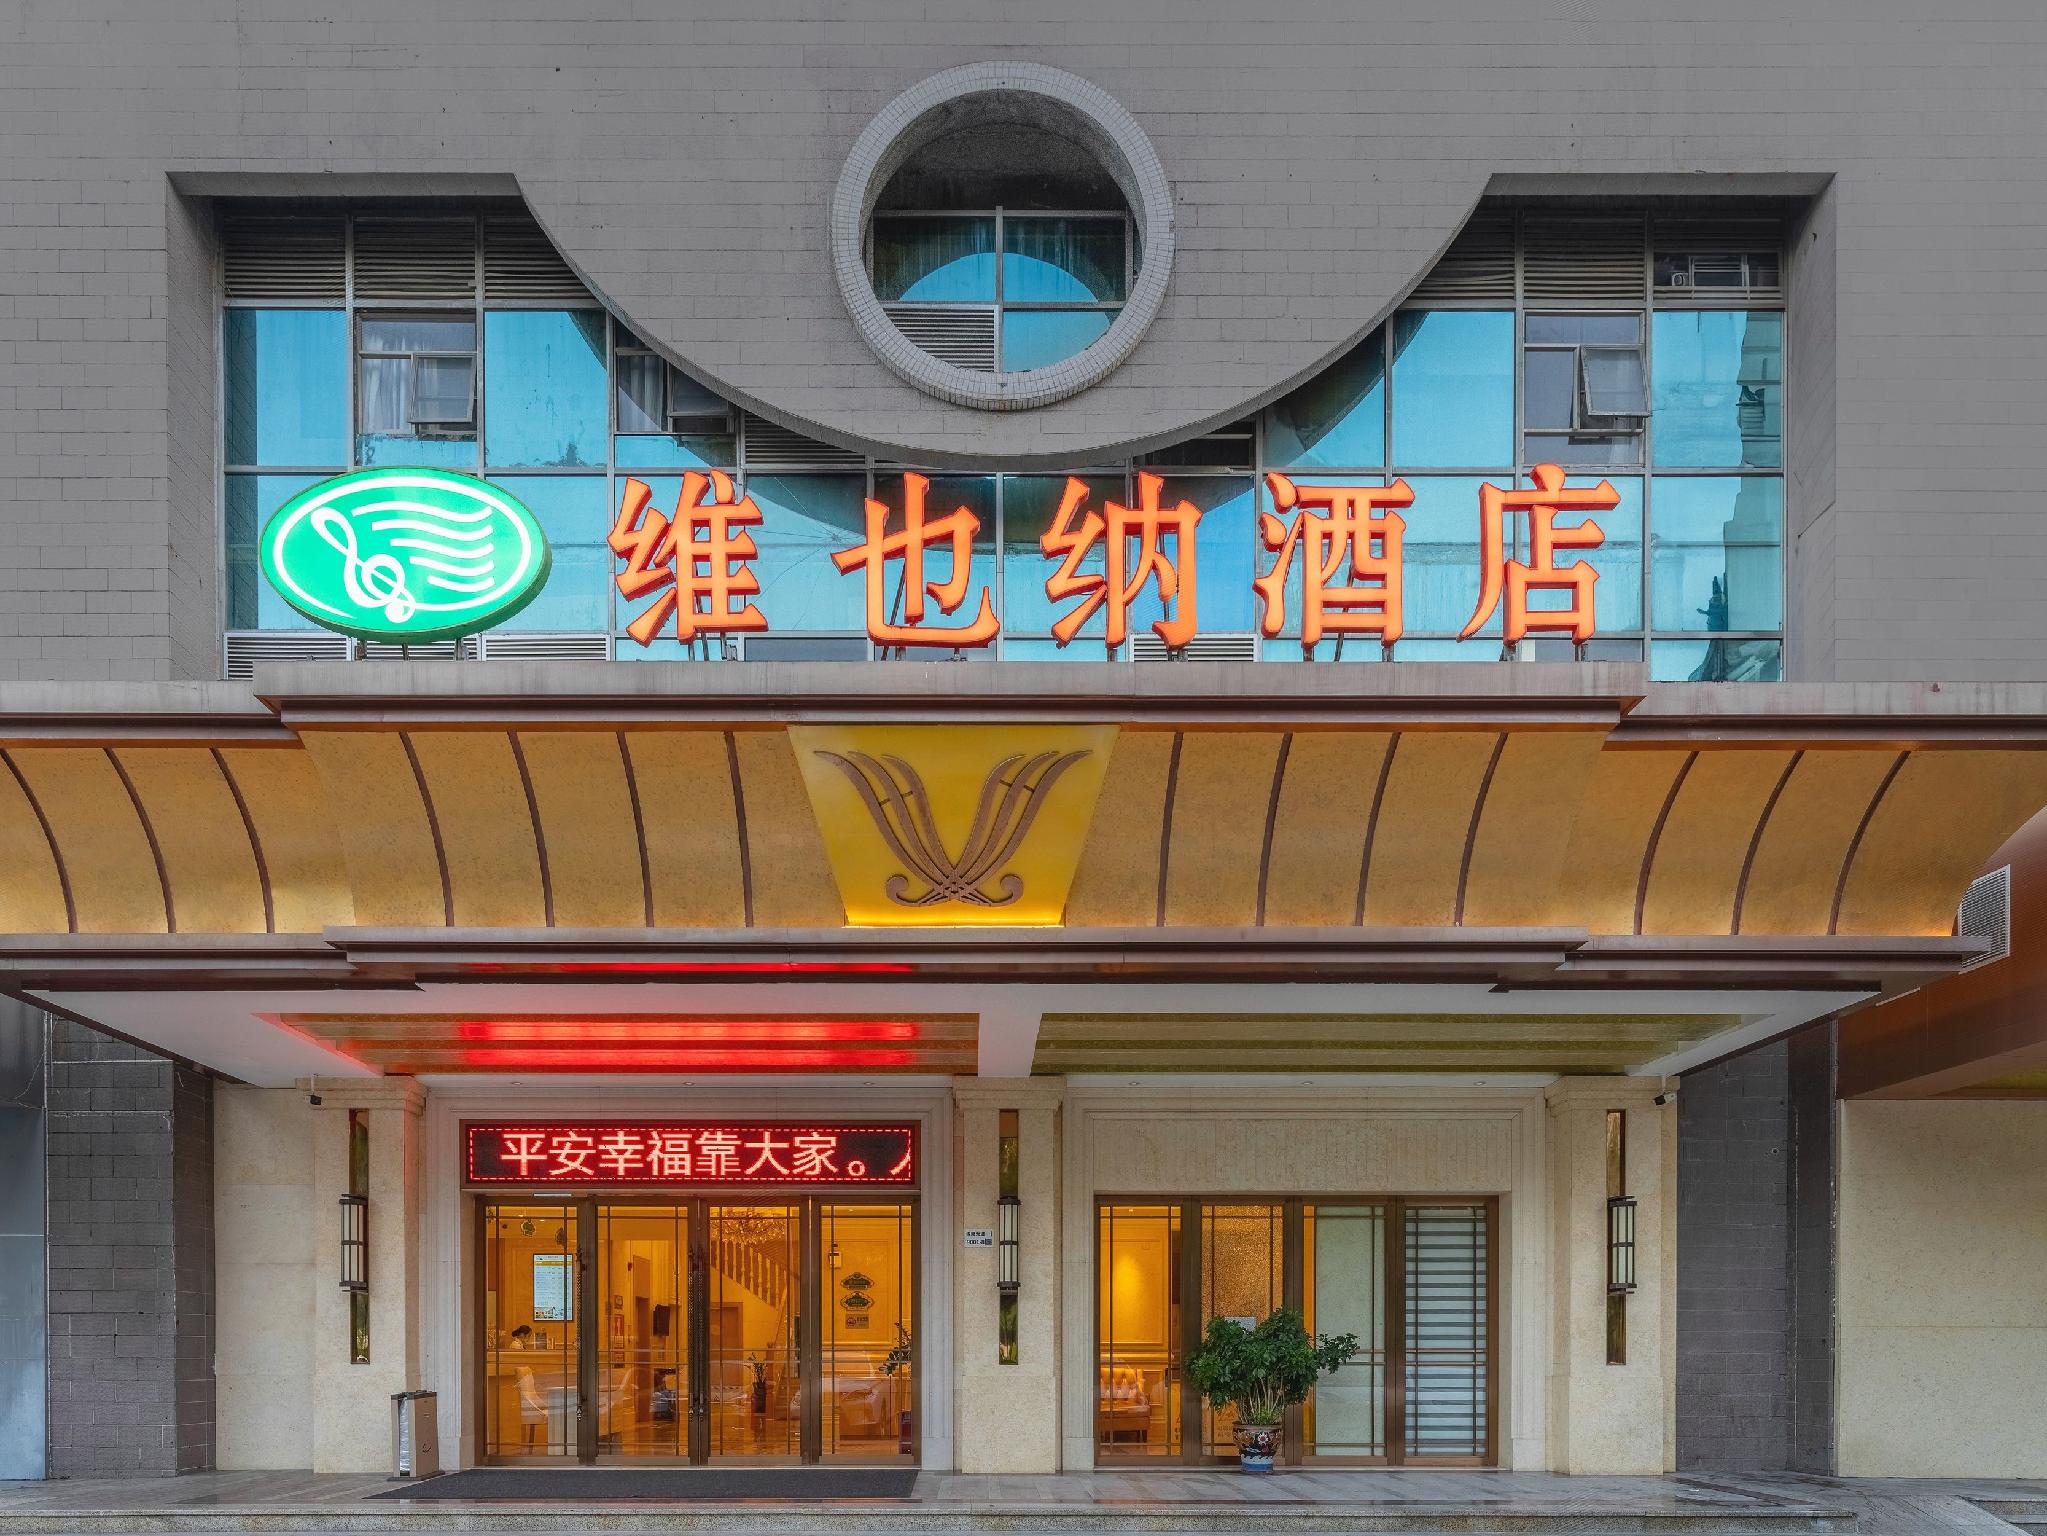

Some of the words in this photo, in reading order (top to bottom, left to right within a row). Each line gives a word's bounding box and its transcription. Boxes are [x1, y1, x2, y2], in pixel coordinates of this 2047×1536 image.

[608, 463, 1620, 647] 维也纳酒店
